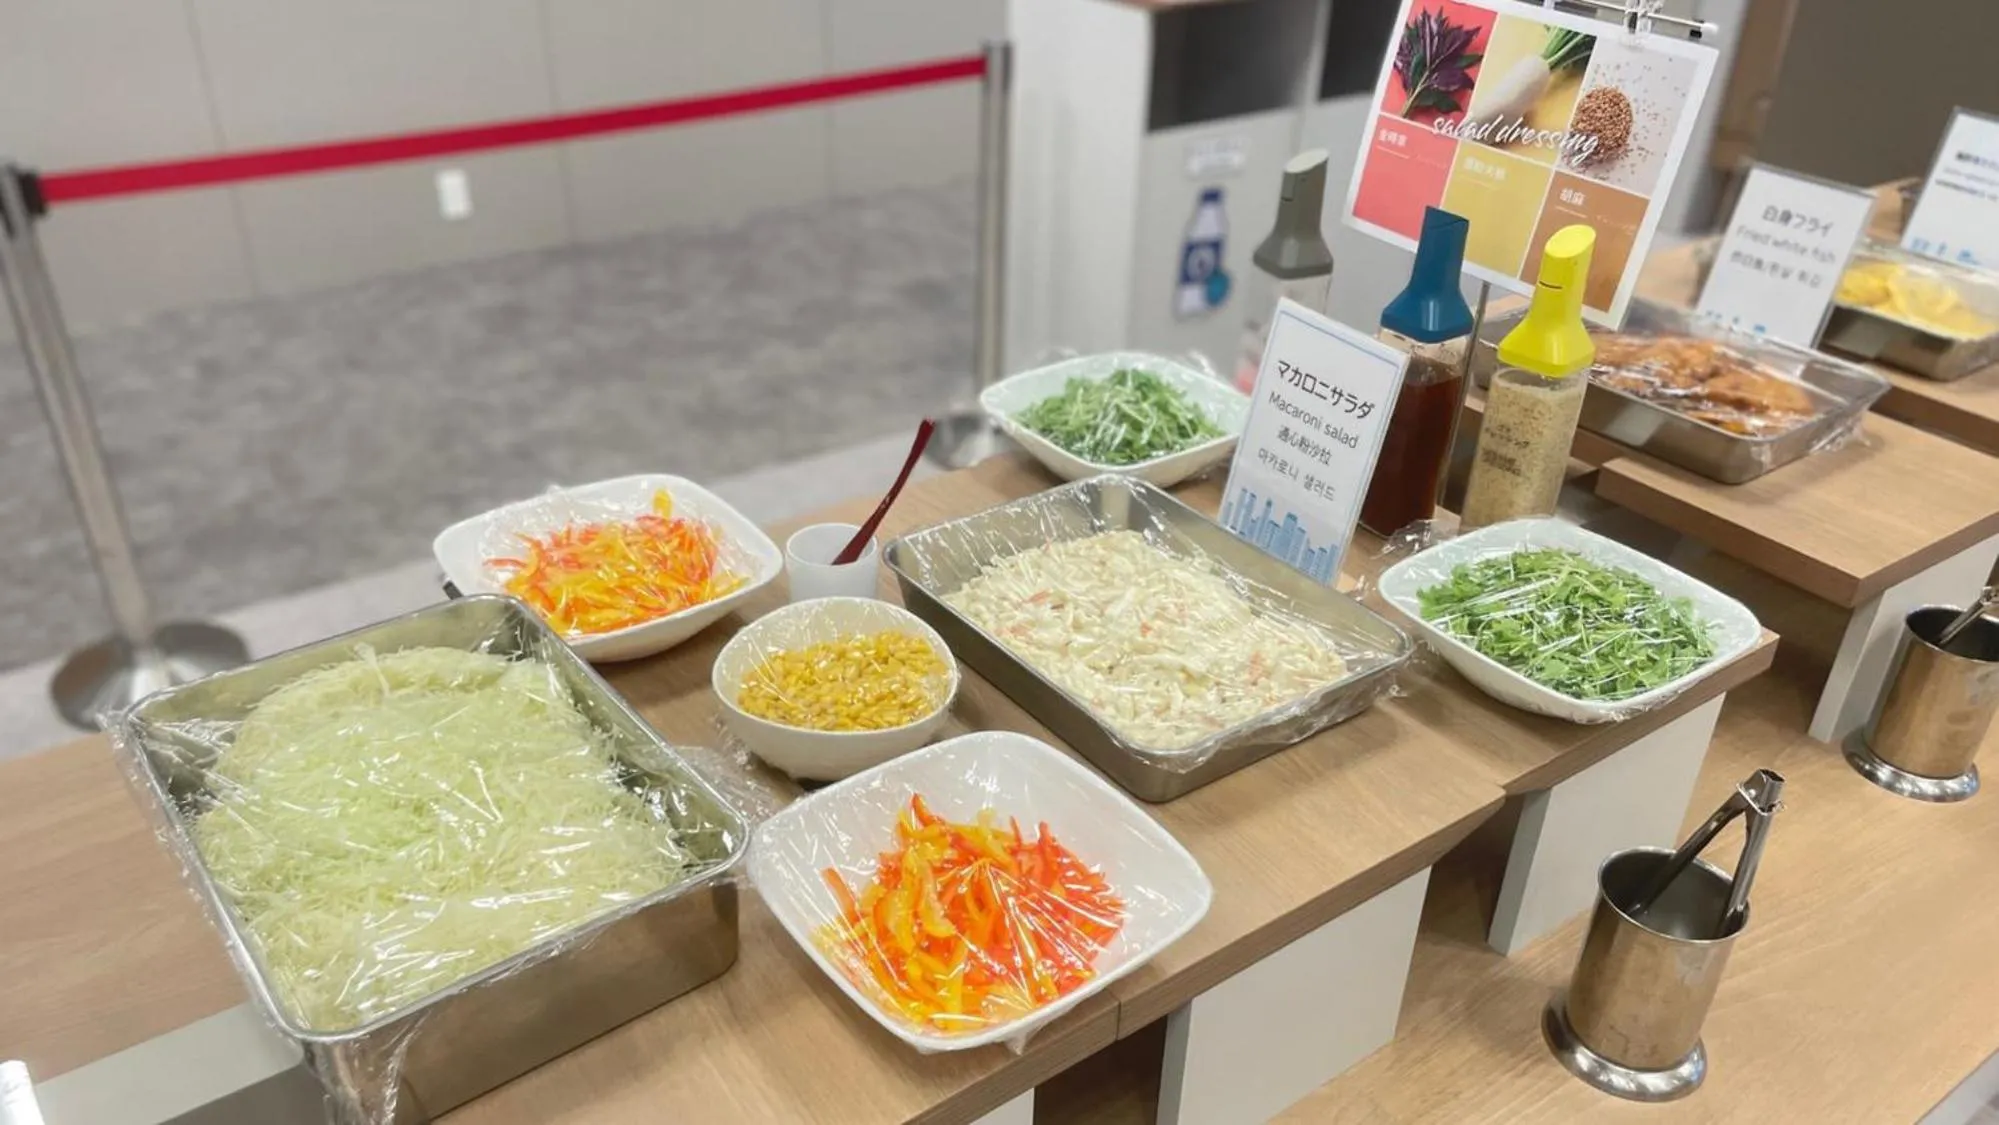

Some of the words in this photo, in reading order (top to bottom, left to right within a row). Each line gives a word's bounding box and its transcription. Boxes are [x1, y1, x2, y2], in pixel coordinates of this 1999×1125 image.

[1432, 114, 1504, 142] salad
[1495, 117, 1599, 167] dressing
[1762, 205, 1834, 238] 白身フライ
[1277, 360, 1376, 420] マカロニサラダ
[1269, 391, 1323, 428] Macaroni
[1323, 423, 1359, 449] salad
[1258, 448, 1298, 480] 마카로니
[1303, 474, 1336, 502] 샐러드
